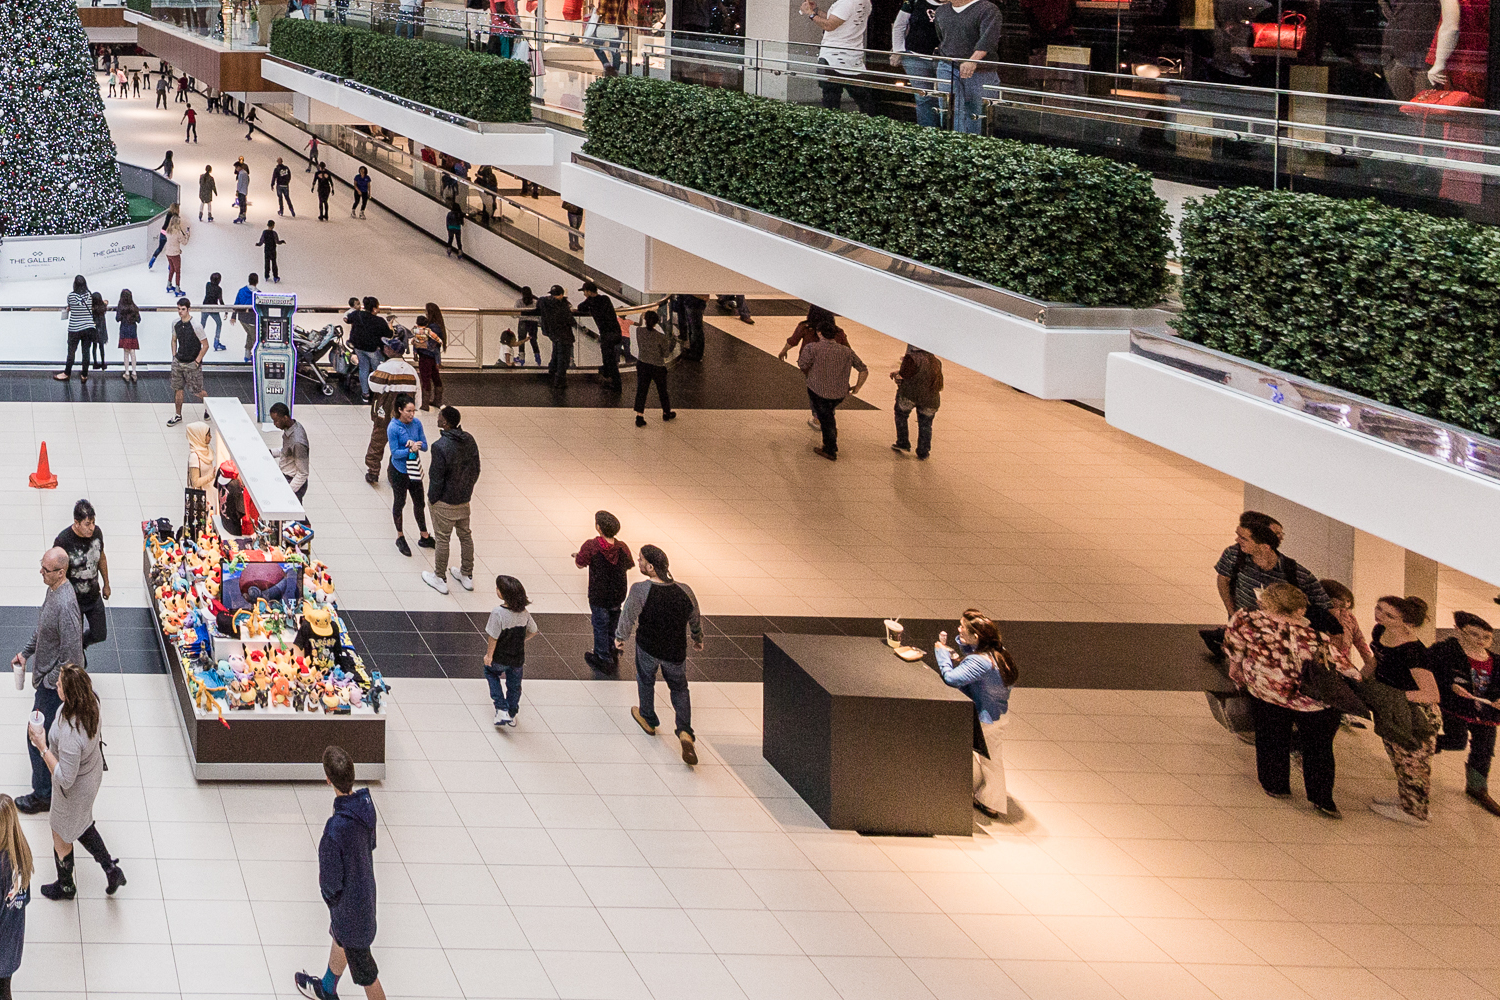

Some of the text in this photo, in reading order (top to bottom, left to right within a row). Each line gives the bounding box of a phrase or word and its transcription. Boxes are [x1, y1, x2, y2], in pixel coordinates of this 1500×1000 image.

[92, 244, 136, 258] THE GALLERIA
[27, 256, 66, 264] GALLERIA
[266, 386, 284, 395] WIN!
